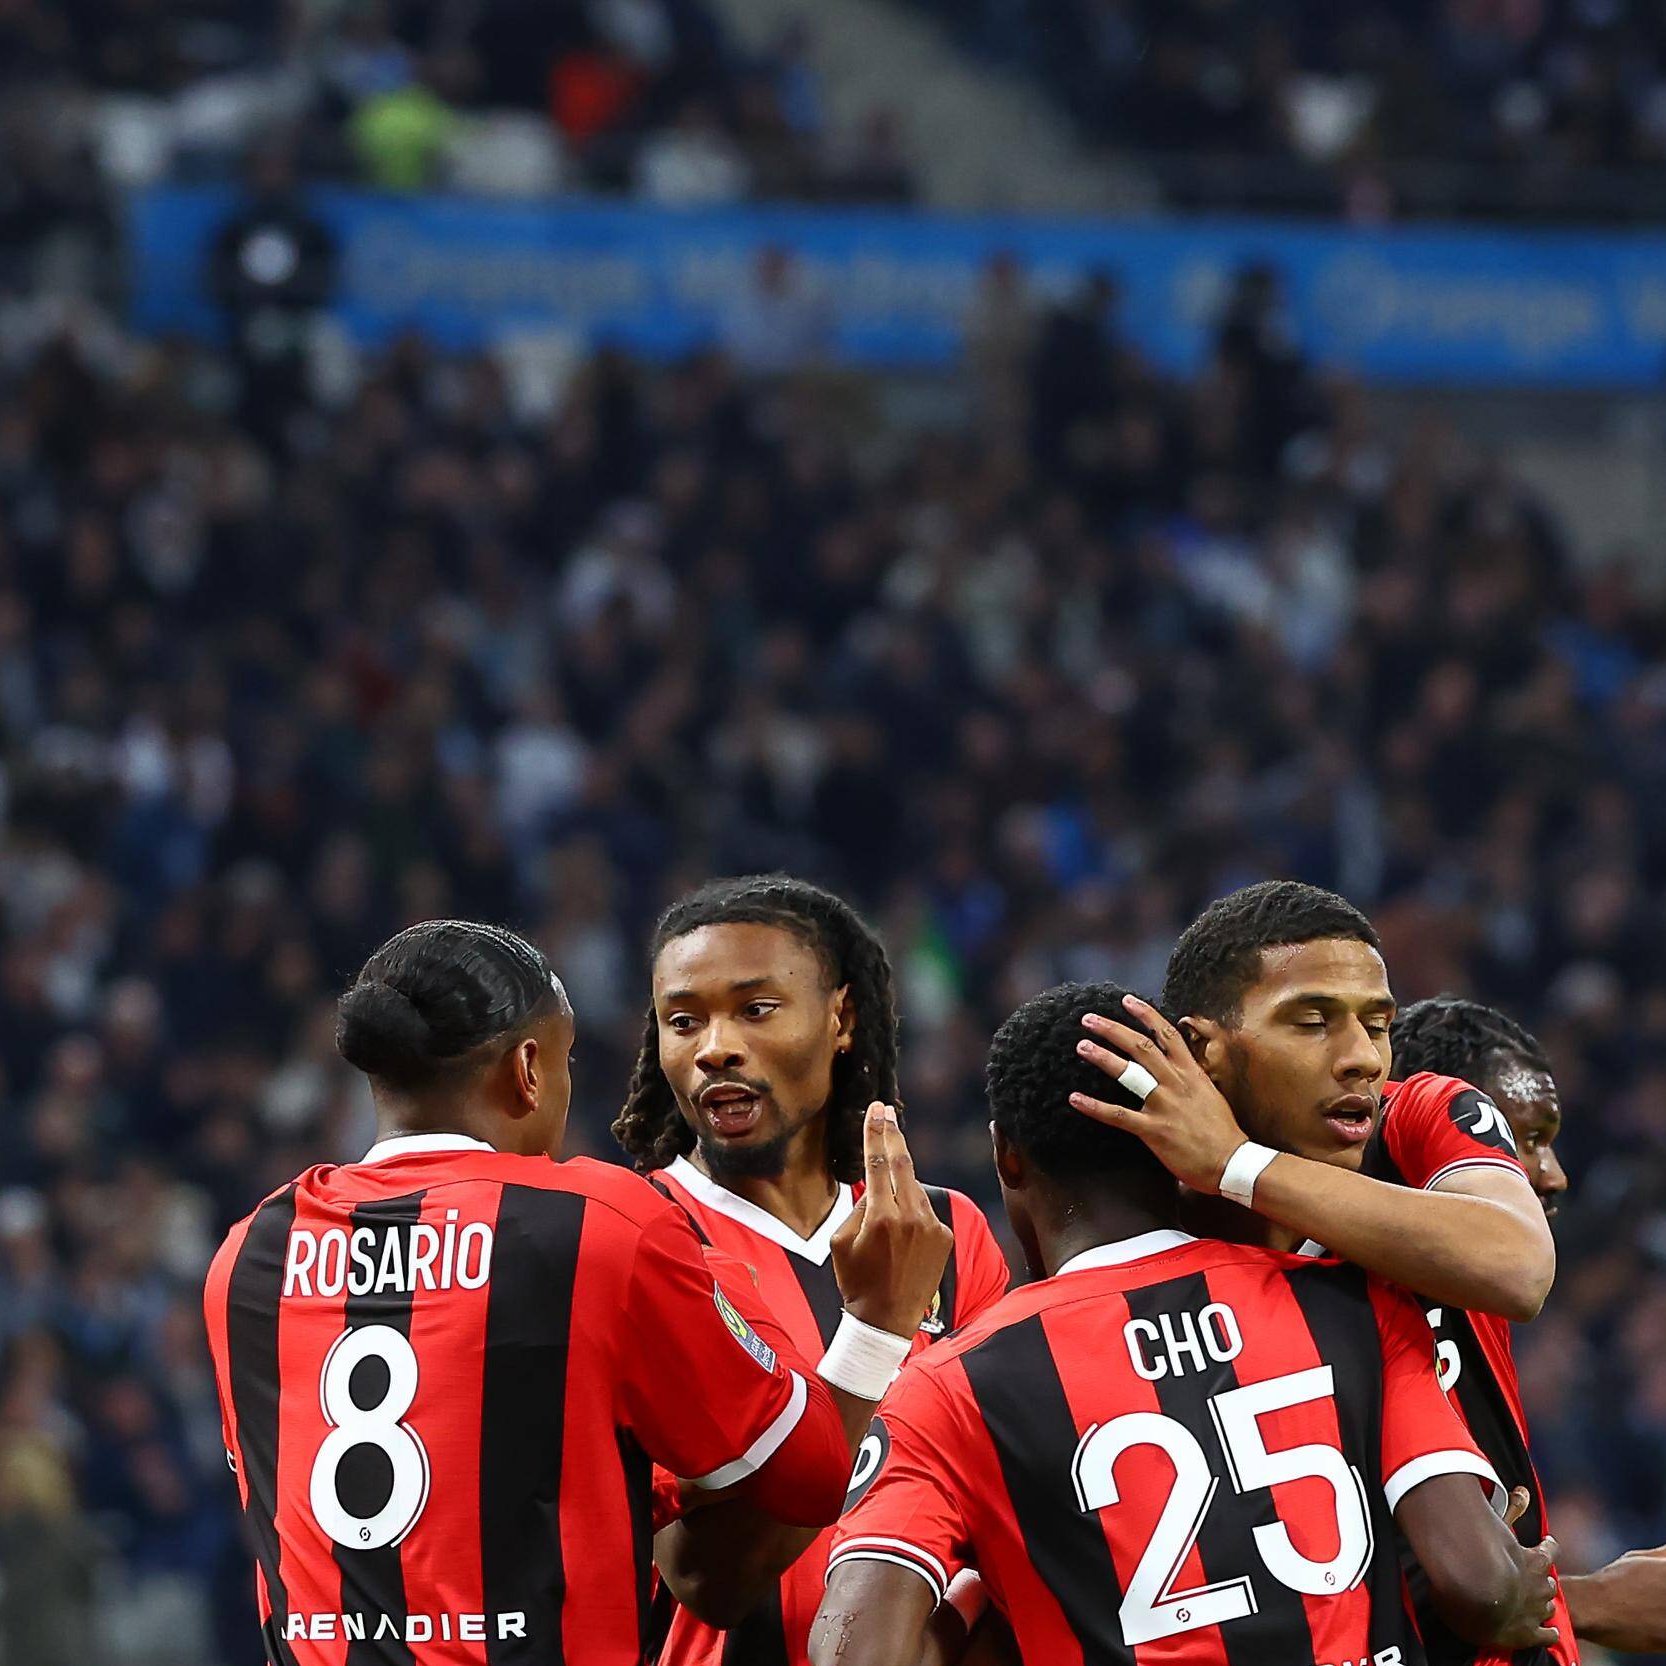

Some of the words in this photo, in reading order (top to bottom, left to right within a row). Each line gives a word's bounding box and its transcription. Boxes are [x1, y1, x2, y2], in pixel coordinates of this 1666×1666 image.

[1123, 1302, 1244, 1381] CHO
[309, 1324, 431, 1550] 8
[847, 1433, 882, 1494] D
[1070, 1364, 1374, 1648] 25
[281, 1612, 527, 1642] RENADIER
